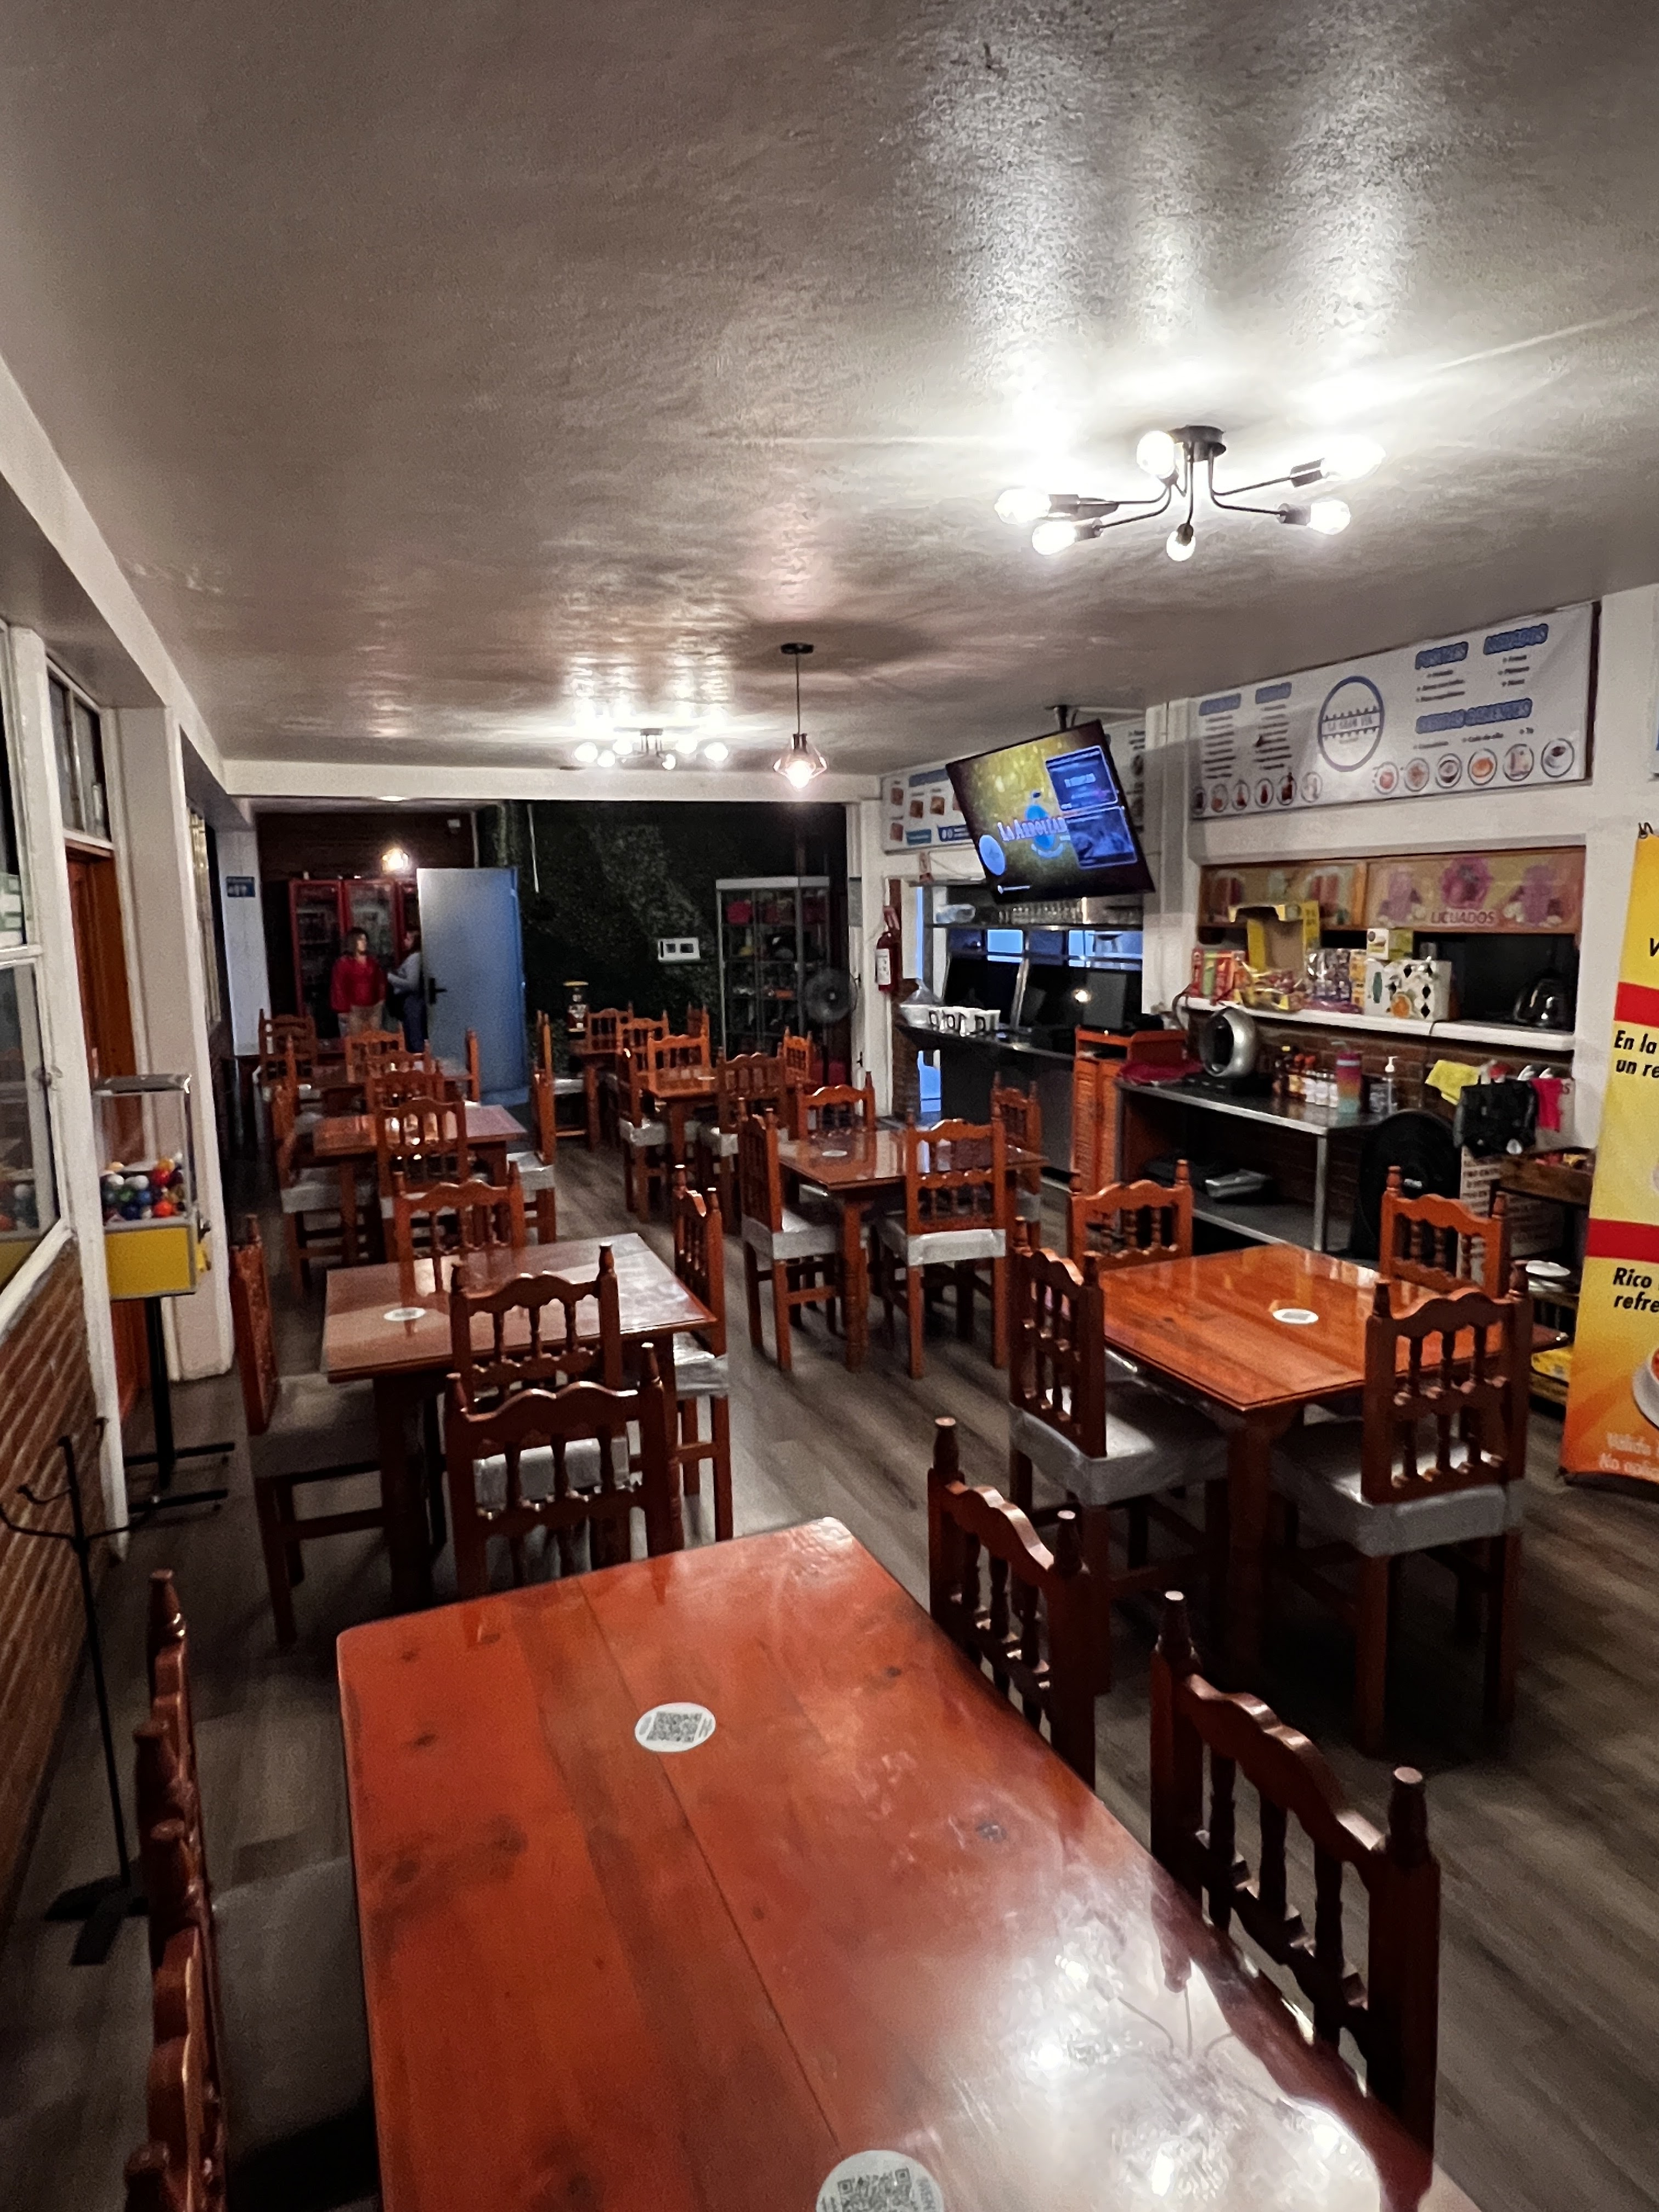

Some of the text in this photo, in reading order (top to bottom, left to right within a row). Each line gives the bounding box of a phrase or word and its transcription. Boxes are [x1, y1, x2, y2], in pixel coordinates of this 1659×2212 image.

[1431, 911, 1495, 924] LICUADOS
[1614, 1030, 1657, 1054] En la
[1616, 1060, 1659, 1079] un re
[1613, 1267, 1652, 1288] Rico
[1614, 1291, 1659, 1313] refre
